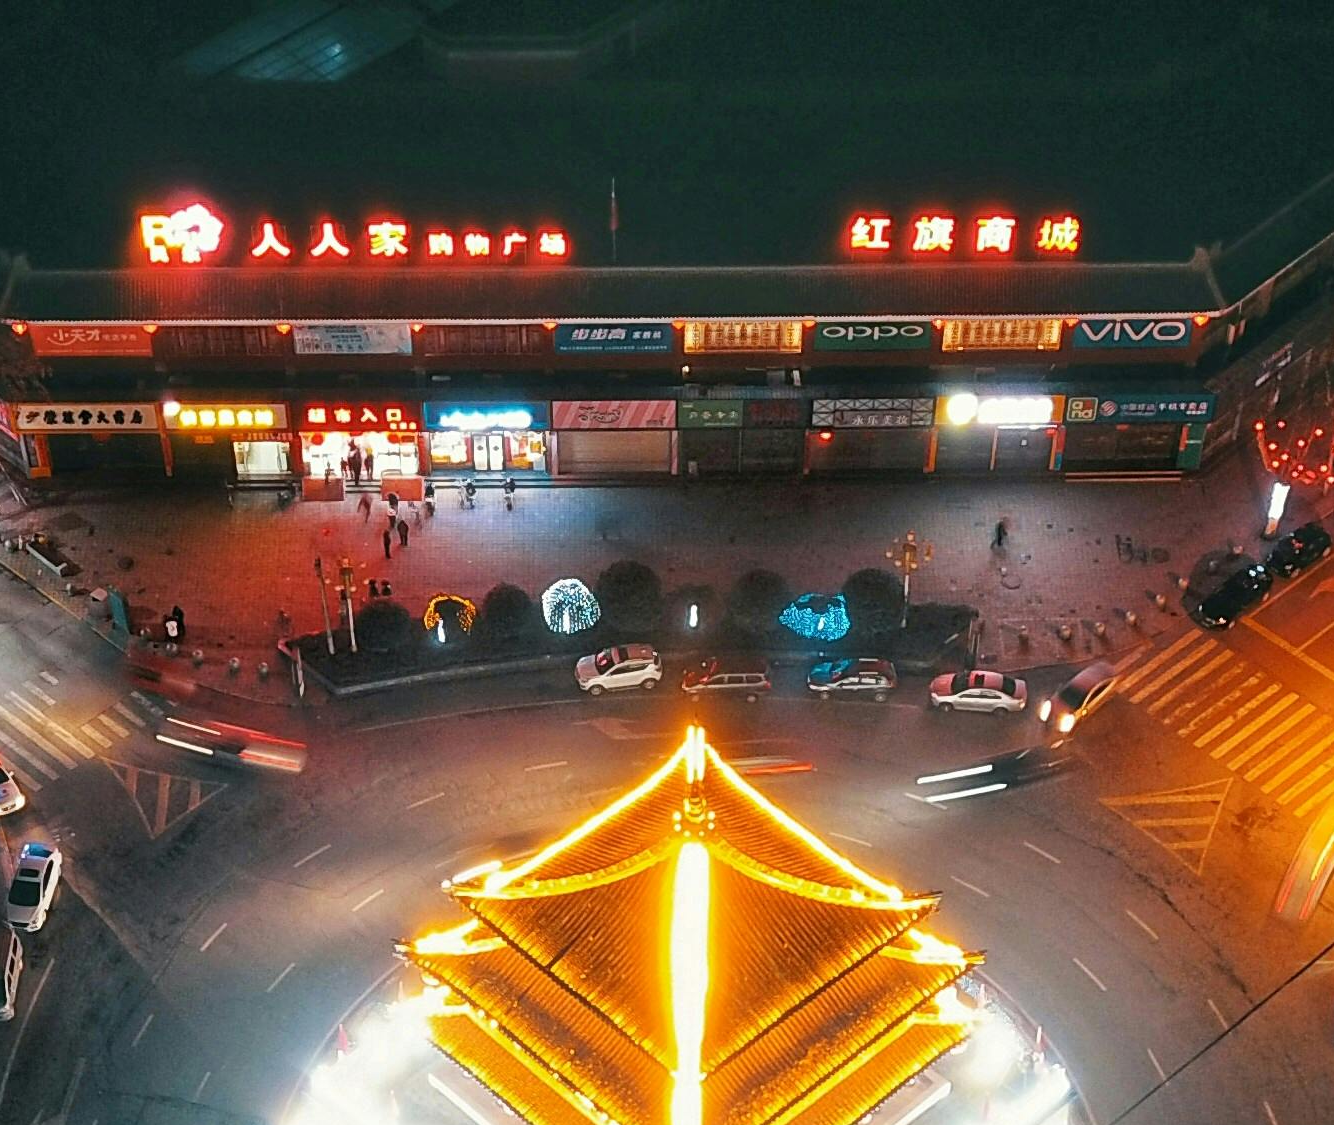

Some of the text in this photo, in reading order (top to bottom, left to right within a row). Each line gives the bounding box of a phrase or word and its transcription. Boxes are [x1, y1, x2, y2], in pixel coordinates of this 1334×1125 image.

[850, 216, 1081, 253] 红旗商城
[50, 328, 101, 343] 小天才
[571, 327, 627, 341] 步步高
